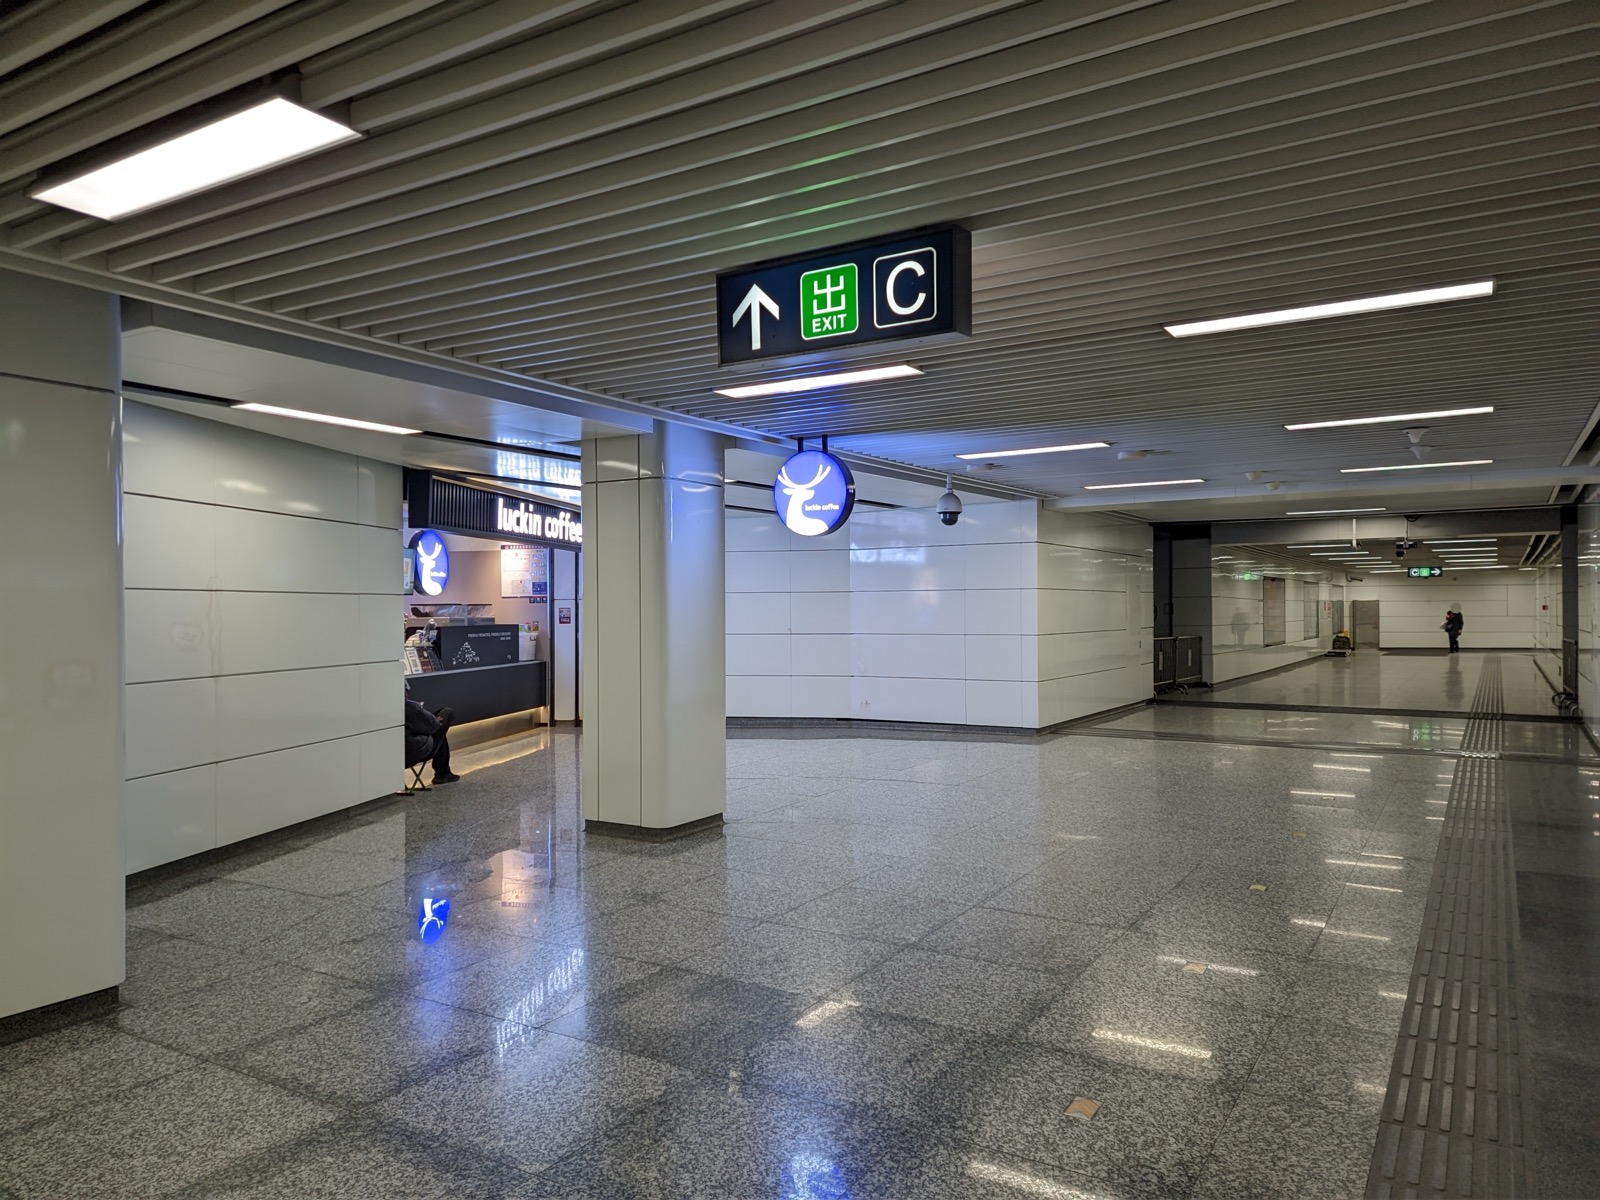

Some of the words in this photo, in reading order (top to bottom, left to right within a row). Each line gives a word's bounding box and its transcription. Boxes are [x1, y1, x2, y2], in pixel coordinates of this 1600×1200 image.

[813, 274, 846, 315] 出
[886, 260, 926, 315] C
[812, 313, 847, 333] EXIT
[497, 497, 542, 536] luckin
[544, 511, 582, 543] coffee
[804, 503, 821, 511] luckin
[822, 502, 839, 511] coffee
